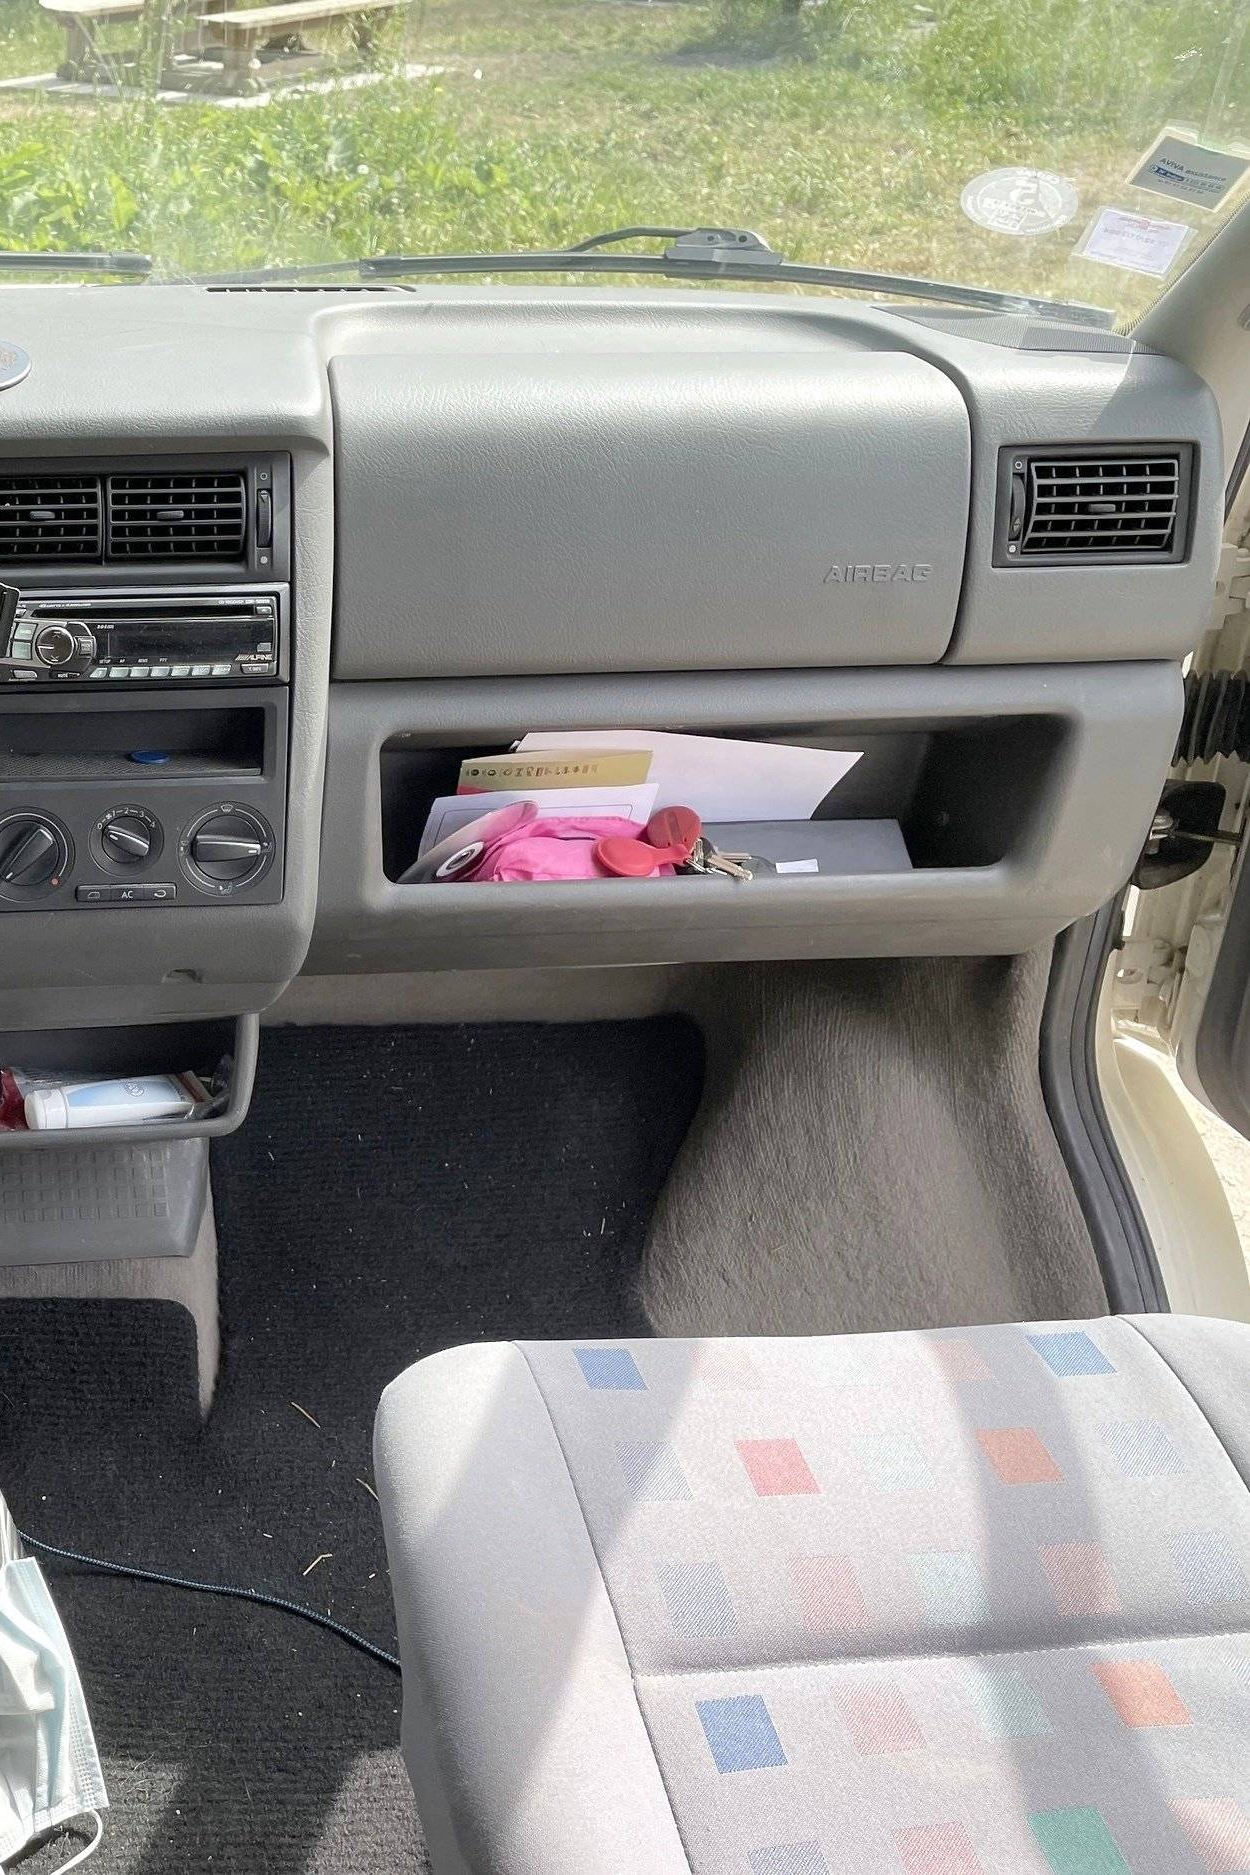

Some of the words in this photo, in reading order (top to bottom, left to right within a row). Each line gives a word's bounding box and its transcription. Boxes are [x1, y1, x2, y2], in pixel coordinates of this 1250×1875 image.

[823, 563, 933, 583] AIRBAG
[236, 653, 273, 661] ALPINE
[121, 891, 134, 899] AC
